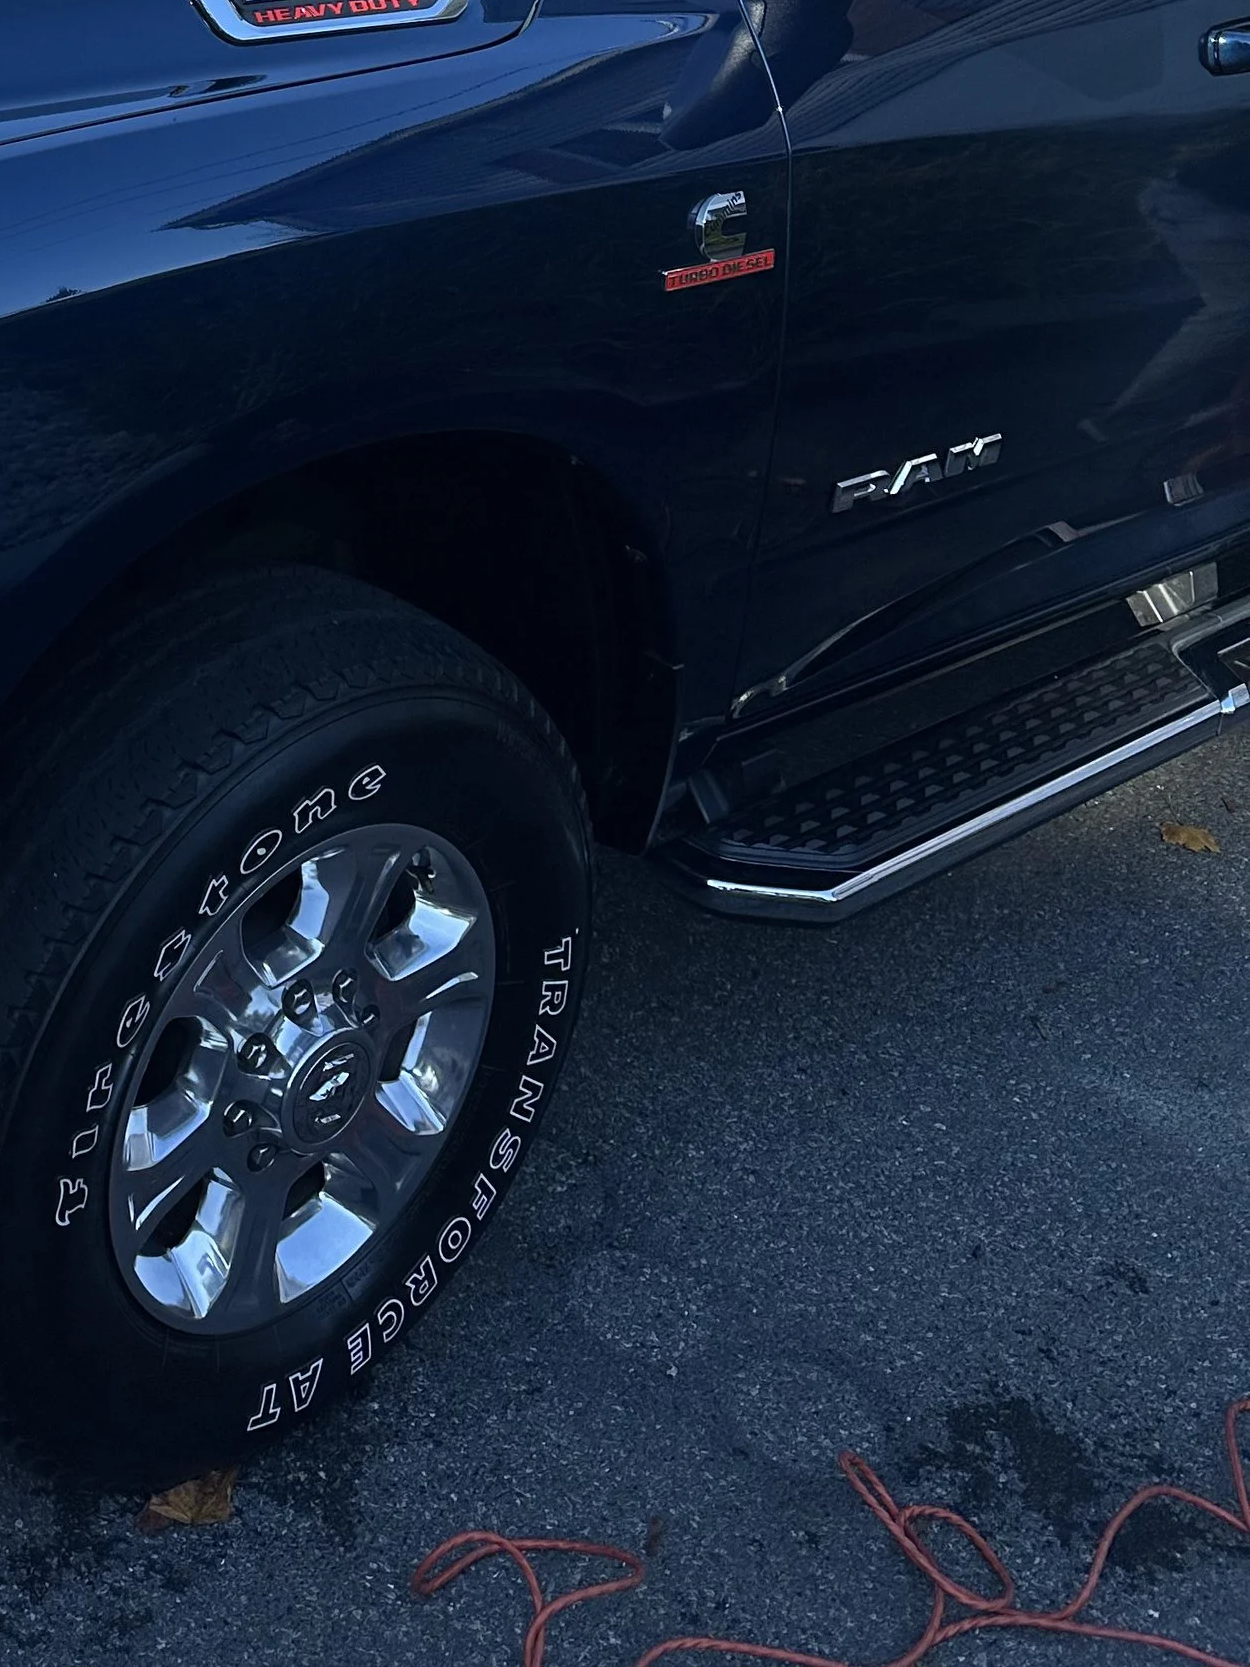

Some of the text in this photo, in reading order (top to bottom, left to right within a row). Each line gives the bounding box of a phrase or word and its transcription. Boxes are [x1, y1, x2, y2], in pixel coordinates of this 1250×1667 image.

[254, 0, 346, 24] HEAVY
[668, 255, 770, 287] TURBO DIESEL
[831, 433, 1002, 514] RAM
[55, 765, 386, 1226] Firestone
[247, 935, 573, 1432] TRANSFORCE AT
